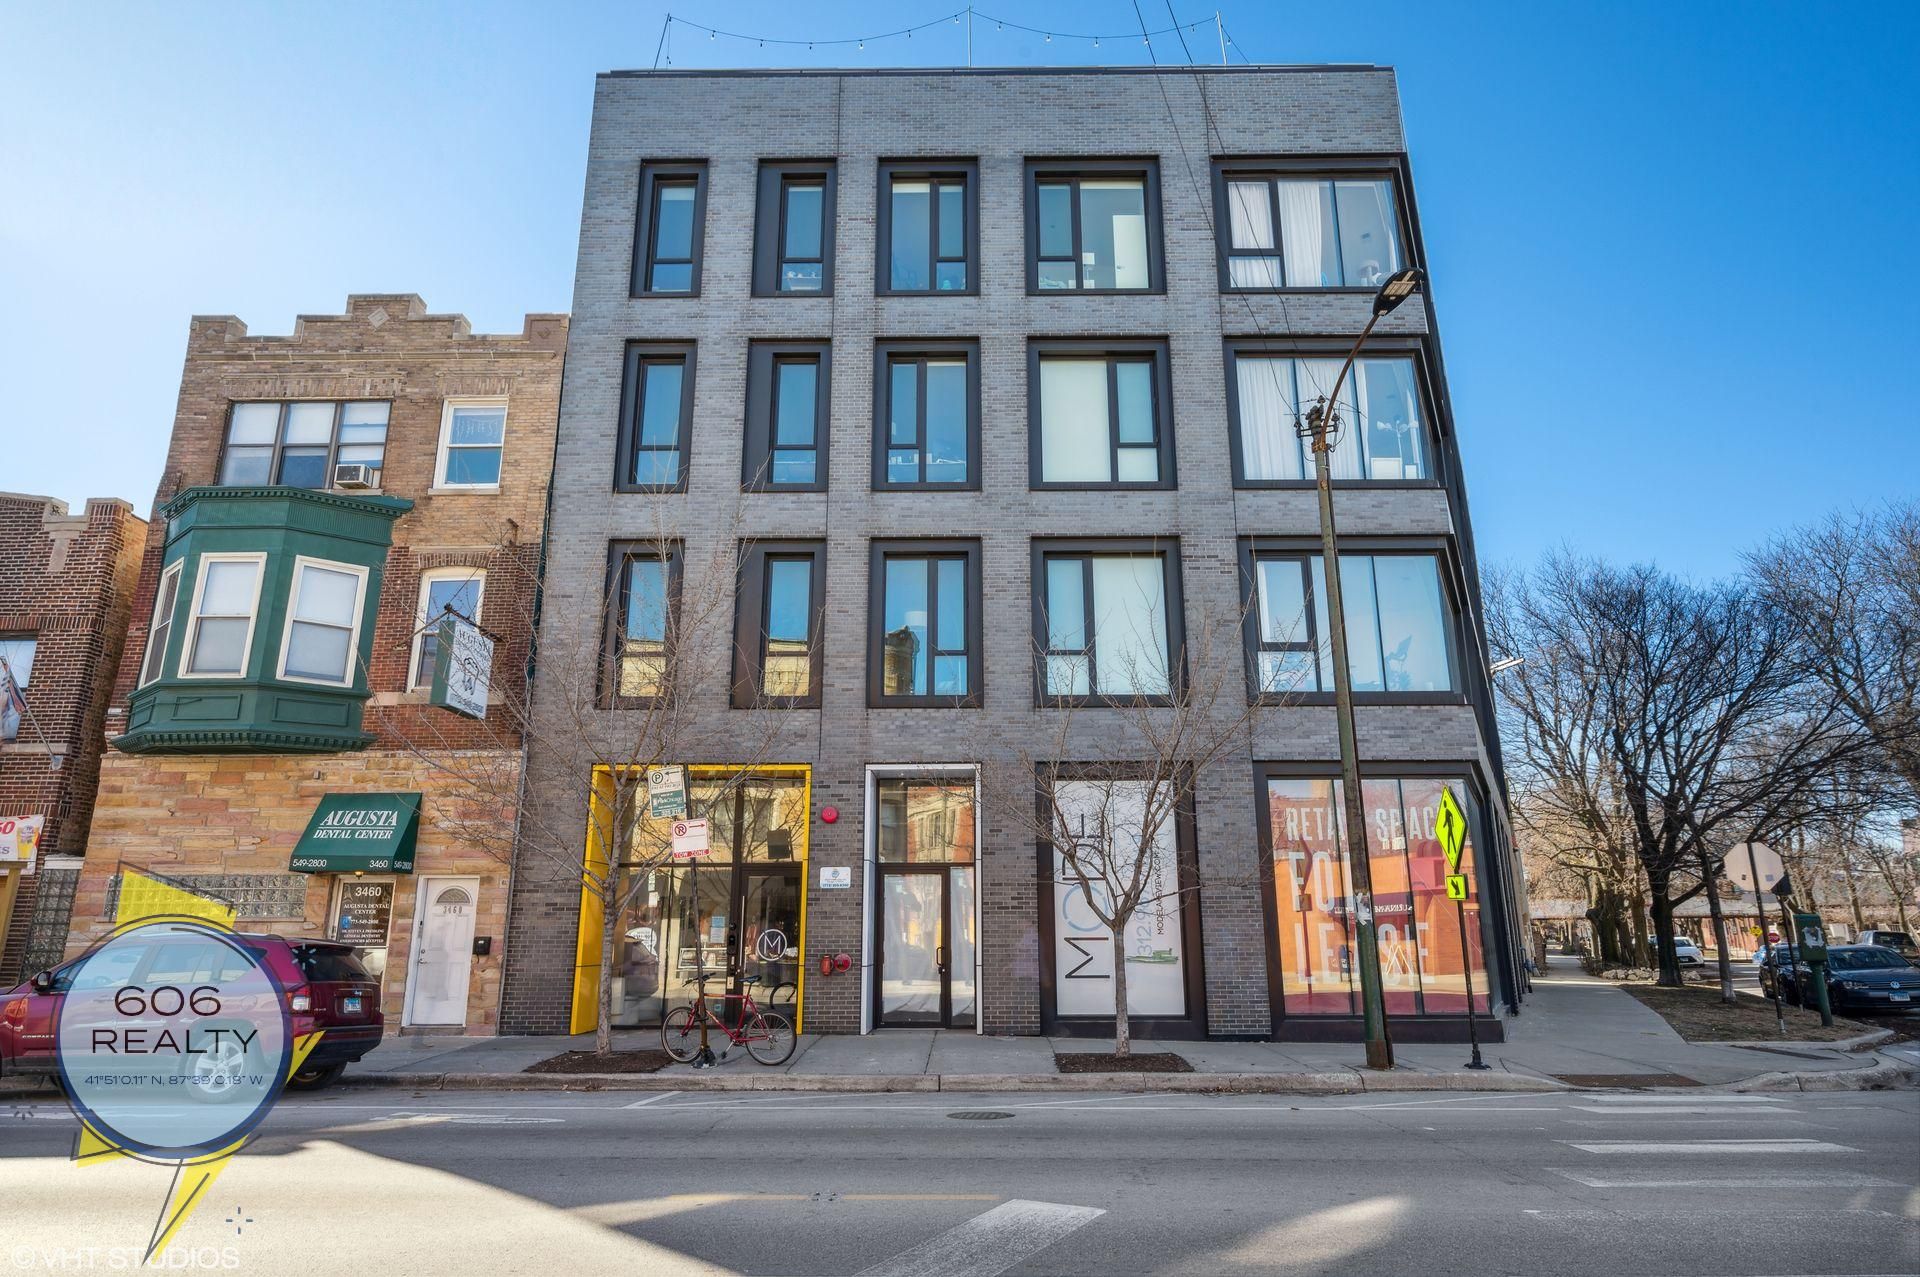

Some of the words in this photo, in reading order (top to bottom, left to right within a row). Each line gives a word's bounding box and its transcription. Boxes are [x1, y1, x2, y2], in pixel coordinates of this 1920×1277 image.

[320, 810, 399, 826] AUGUSTA
[1375, 806, 1438, 842] SPAC
[313, 829, 352, 839] DENTAL
[354, 829, 394, 839] CENTER
[292, 858, 327, 868] 549-2800
[369, 860, 389, 868] 3460
[394, 860, 413, 870] 549-2800
[1288, 851, 1356, 912] FO
[355, 886, 382, 897] 3460
[442, 905, 463, 914] 3460
[764, 935, 781, 954] M
[1294, 922, 1436, 985] LESE
